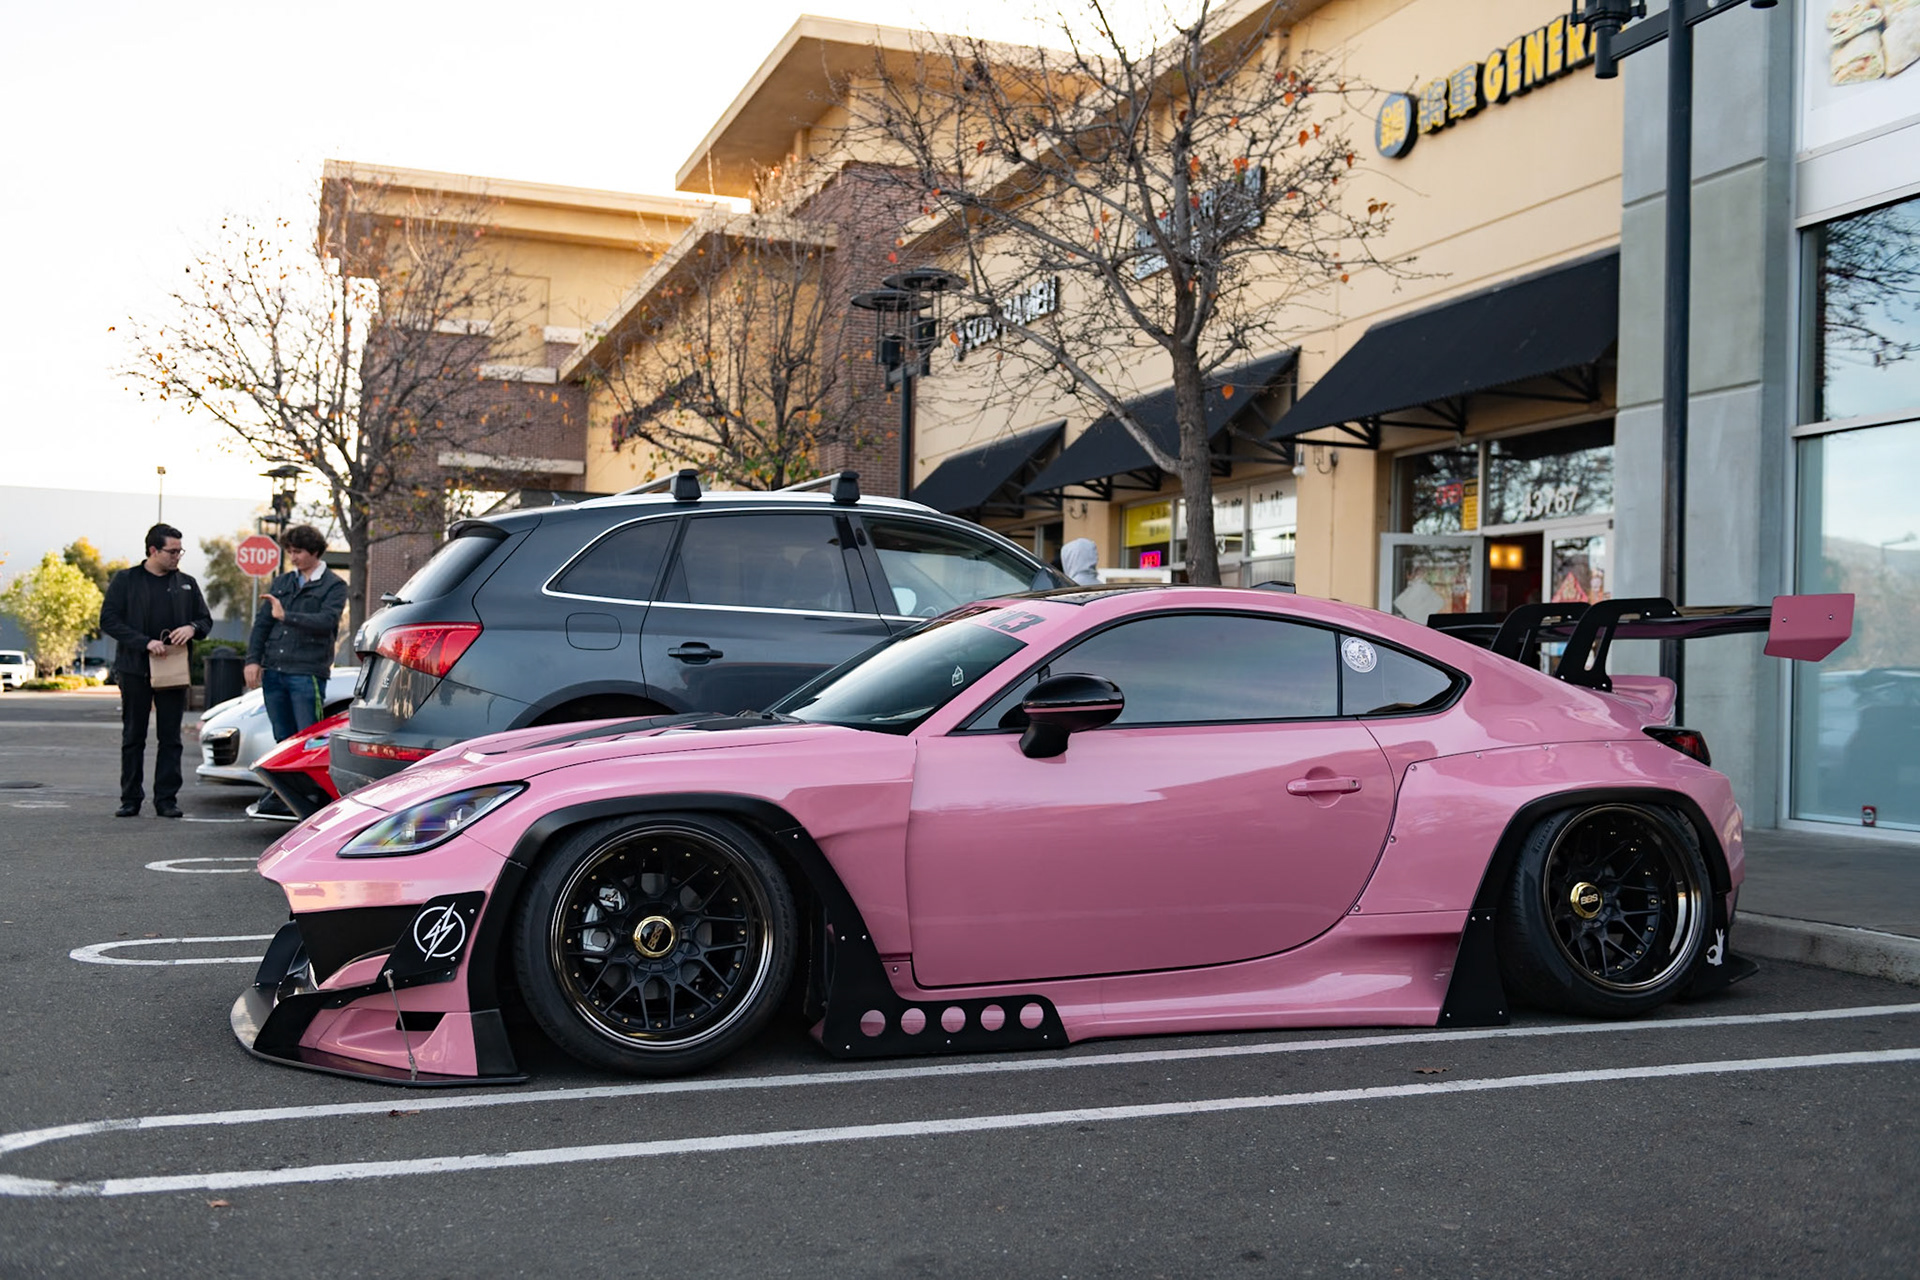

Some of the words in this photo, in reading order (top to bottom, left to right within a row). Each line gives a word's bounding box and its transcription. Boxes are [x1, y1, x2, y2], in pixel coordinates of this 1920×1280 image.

[1483, 13, 1625, 103] GENER
[1522, 484, 1578, 517] 43767
[239, 546, 278, 565] STOP
[1580, 893, 1599, 905] BBS
